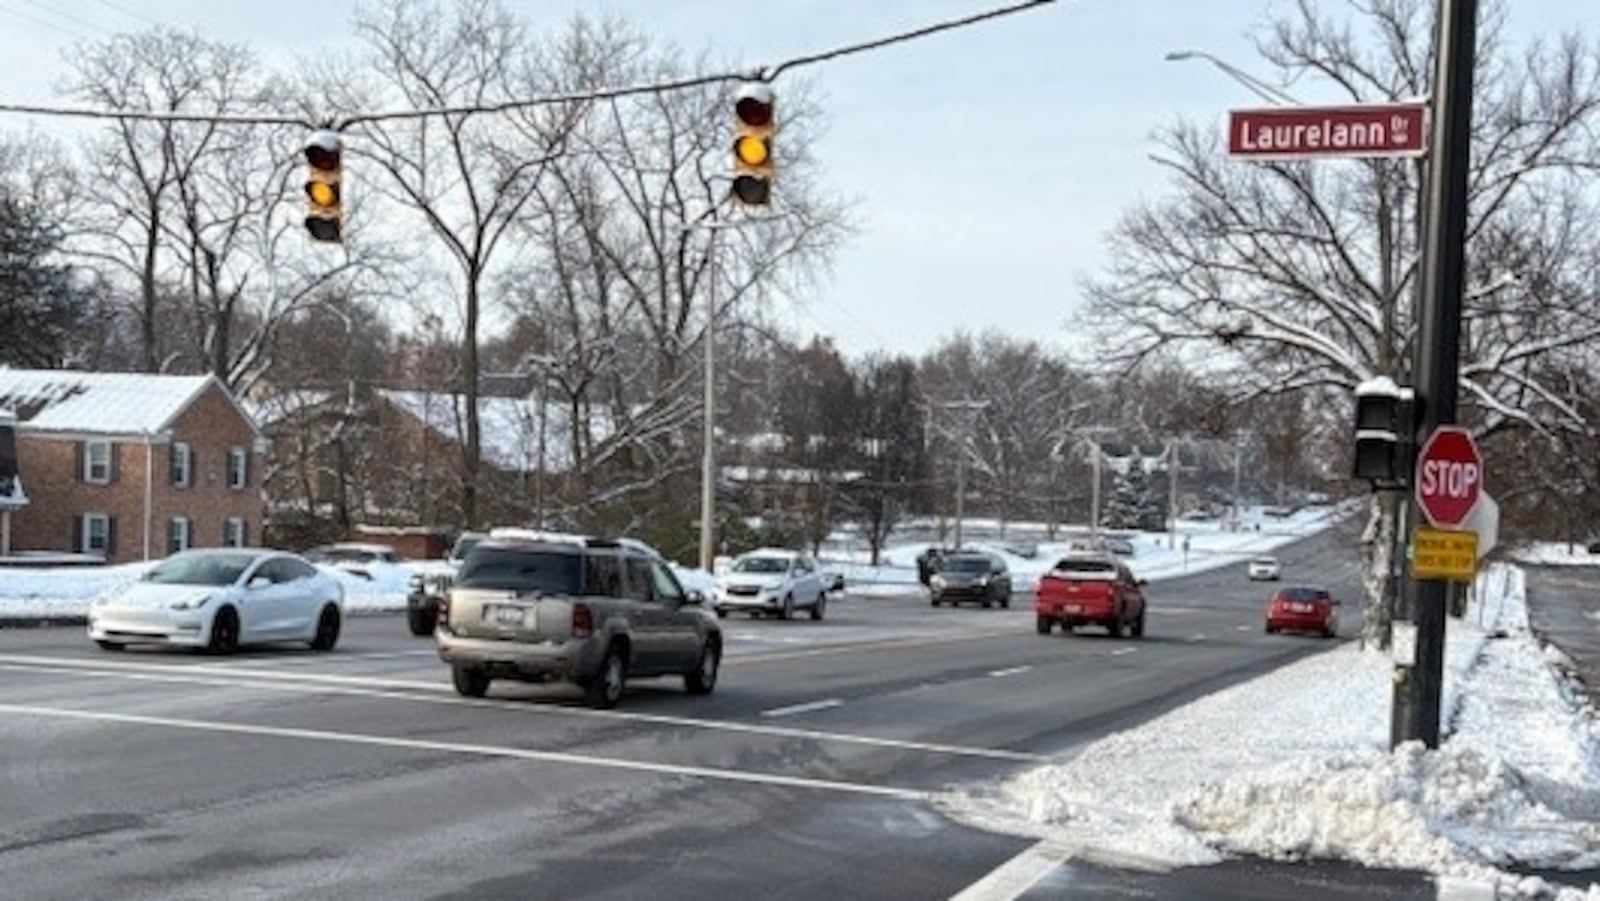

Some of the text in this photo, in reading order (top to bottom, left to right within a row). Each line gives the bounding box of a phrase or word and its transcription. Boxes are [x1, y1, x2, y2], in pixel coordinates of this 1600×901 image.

[1240, 119, 1384, 148] Laurelann
[1391, 114, 1409, 131] Dr
[1422, 460, 1478, 498] STOP
